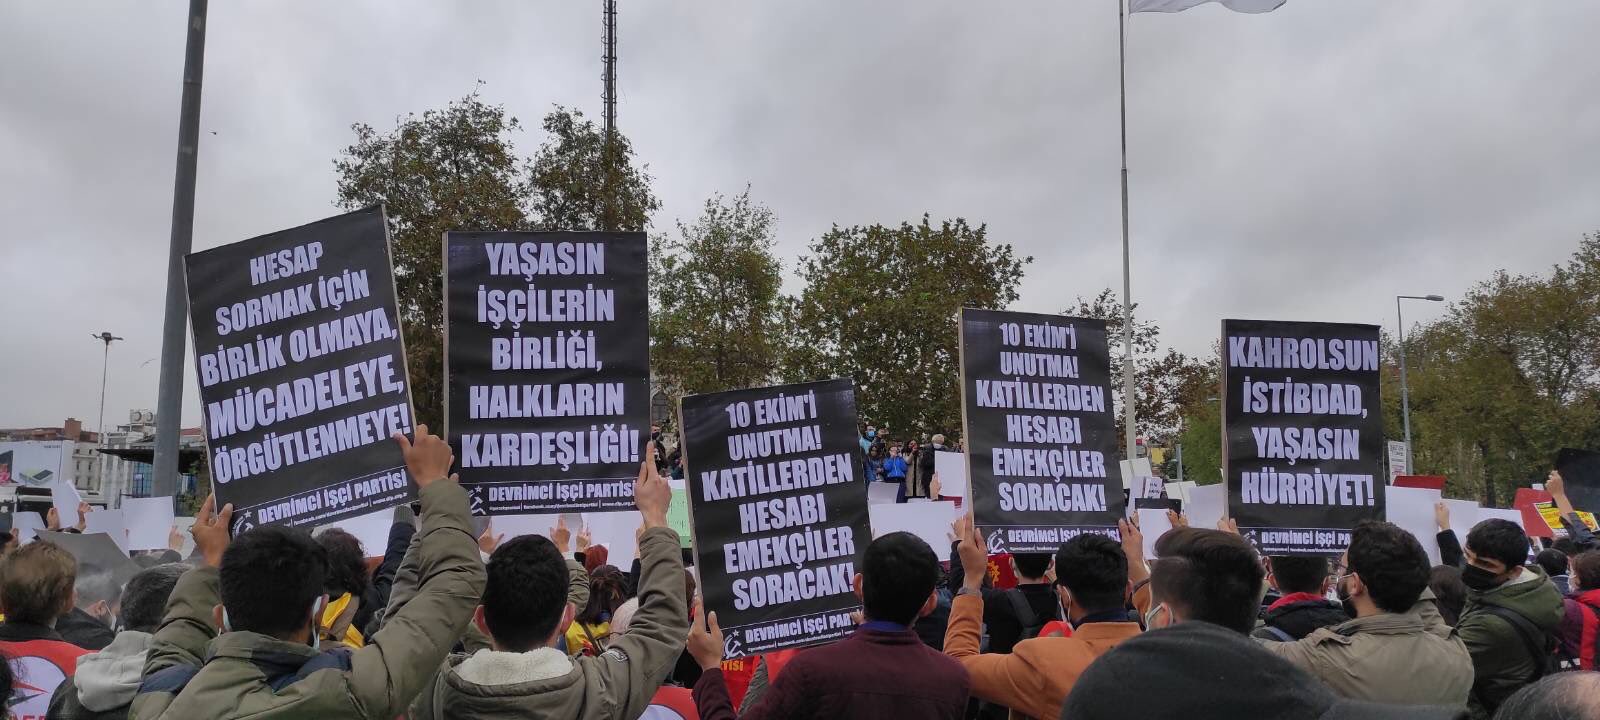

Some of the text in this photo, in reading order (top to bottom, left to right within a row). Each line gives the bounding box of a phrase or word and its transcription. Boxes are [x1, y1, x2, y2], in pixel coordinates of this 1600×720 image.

[249, 241, 323, 286] HESAP
[485, 241, 605, 282] YAŞASIN
[215, 269, 370, 336] SORMAK İÇİN
[477, 283, 615, 329] İŞÇİLERİN
[200, 307, 398, 388] BİRLİK OLMAYA,
[492, 329, 603, 372] BİRLİĞİ,
[999, 321, 1077, 350] 10 EKİM'İ
[1229, 336, 1379, 371] KAHROLSUN
[1000, 351, 1079, 379] UNUTMA!
[207, 354, 404, 440] MÜCADELEYE,
[469, 382, 625, 419] HALKLARIN
[725, 389, 817, 429] 10 EKİM'İ
[975, 376, 1105, 413] KATİLLERDEN
[1242, 376, 1368, 419] İSTİBDAD,
[214, 402, 411, 484] ÖRGÜTLENMEYE!
[461, 423, 639, 471] KARDEŞLİĞİ!
[727, 425, 822, 461] UNUTMA!
[1006, 414, 1082, 444] HESABI
[1251, 426, 1360, 466] YAŞASIN
[701, 453, 854, 502] KATİLLERDEN
[992, 445, 1106, 483] EMEKÇİLER
[258, 490, 322, 525] DEVRİMCİ
[323, 482, 353, 508] İŞÇİ
[354, 469, 408, 499] PARTİSİ
[488, 479, 636, 502] DEVRİMCİ İŞÇİ PARTİSİ
[998, 483, 1107, 512] SORACAK!
[1241, 466, 1375, 507] HÜRRİYET!
[738, 493, 827, 534] HESABI
[723, 525, 855, 574] EMEKÇİLER
[1007, 527, 1058, 543] DEVRİMCİ
[1261, 530, 1314, 545] DEVRİMCİ
[1315, 530, 1336, 548] İŞÇİ
[732, 562, 855, 611] SORACAK!
[745, 618, 802, 644] DEVRİMCİ
[803, 614, 828, 635] İŞÇİ
